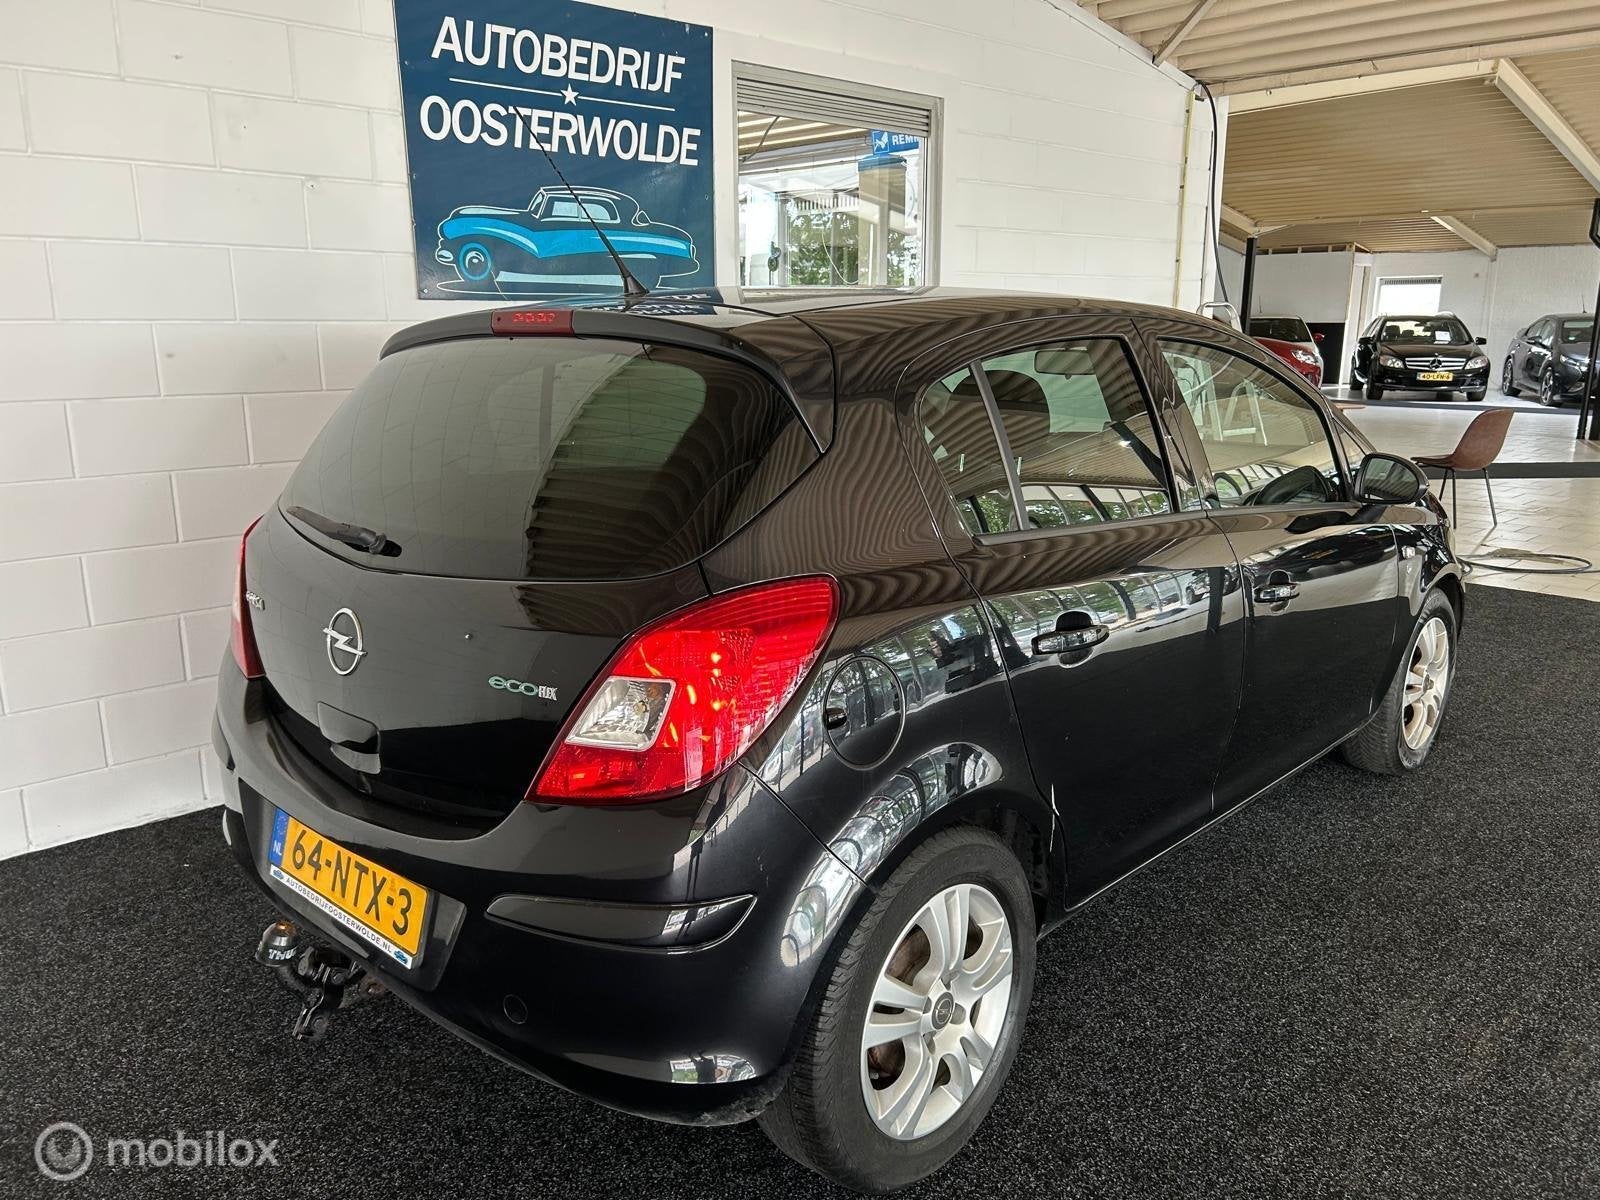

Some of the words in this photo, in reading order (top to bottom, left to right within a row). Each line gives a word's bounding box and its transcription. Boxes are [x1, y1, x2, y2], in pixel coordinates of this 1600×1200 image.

[431, 16, 685, 93] AUTOBEDRIJF
[420, 95, 701, 166] OOSTERWOLDE
[273, 840, 282, 856] NL
[292, 829, 412, 935] 64-NTX-3
[286, 877, 392, 953] AUTOBEDRIJFOOSTERWOLDE.NL
